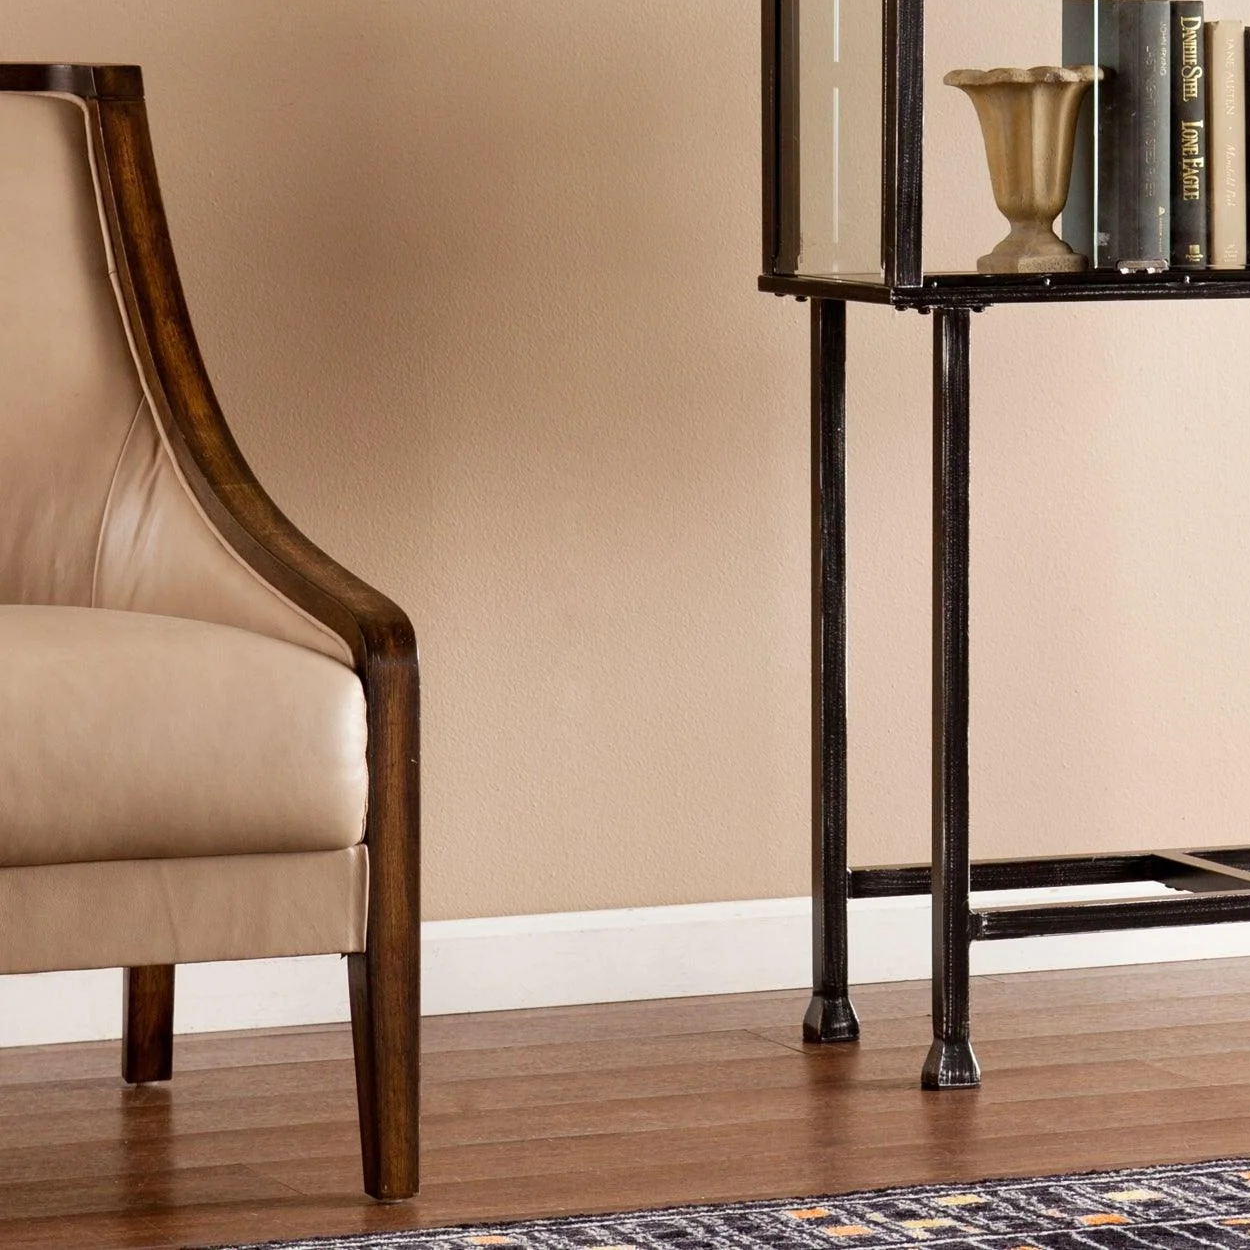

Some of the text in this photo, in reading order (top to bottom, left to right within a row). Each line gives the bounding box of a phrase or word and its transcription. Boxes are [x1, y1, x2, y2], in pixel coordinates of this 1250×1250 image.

[1160, 47, 1168, 76] IRVING
[1224, 38, 1235, 68] JANE
[1180, 16, 1204, 201] DANIELLE STEEL LONE EAGLE
[1225, 70, 1235, 115] AUSTEN
